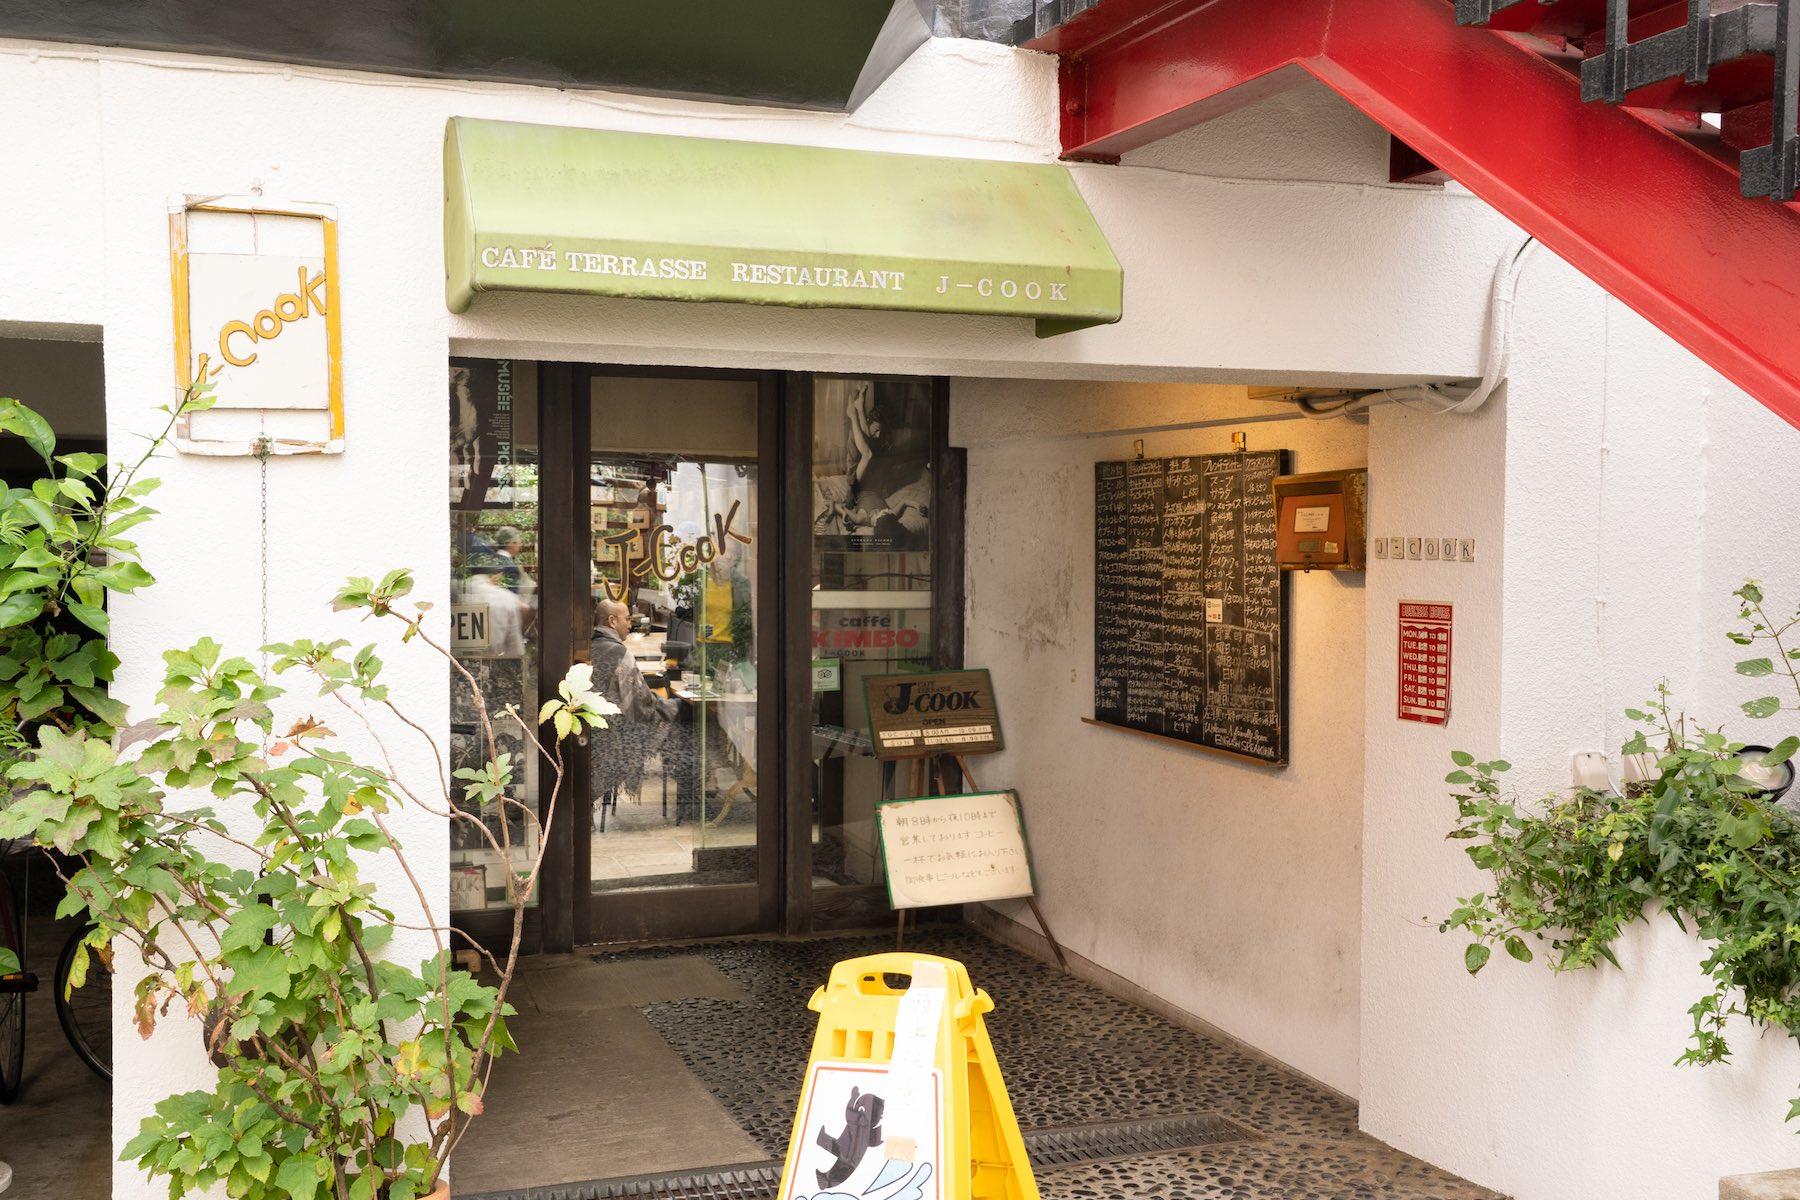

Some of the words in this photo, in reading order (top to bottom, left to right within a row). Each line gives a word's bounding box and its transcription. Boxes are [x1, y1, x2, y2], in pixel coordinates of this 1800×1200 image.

[482, 243, 557, 270] CAFÉ
[565, 252, 706, 280] TERRASSE
[731, 263, 904, 290] RESTAURANT
[936, 276, 1067, 300] J-COOK
